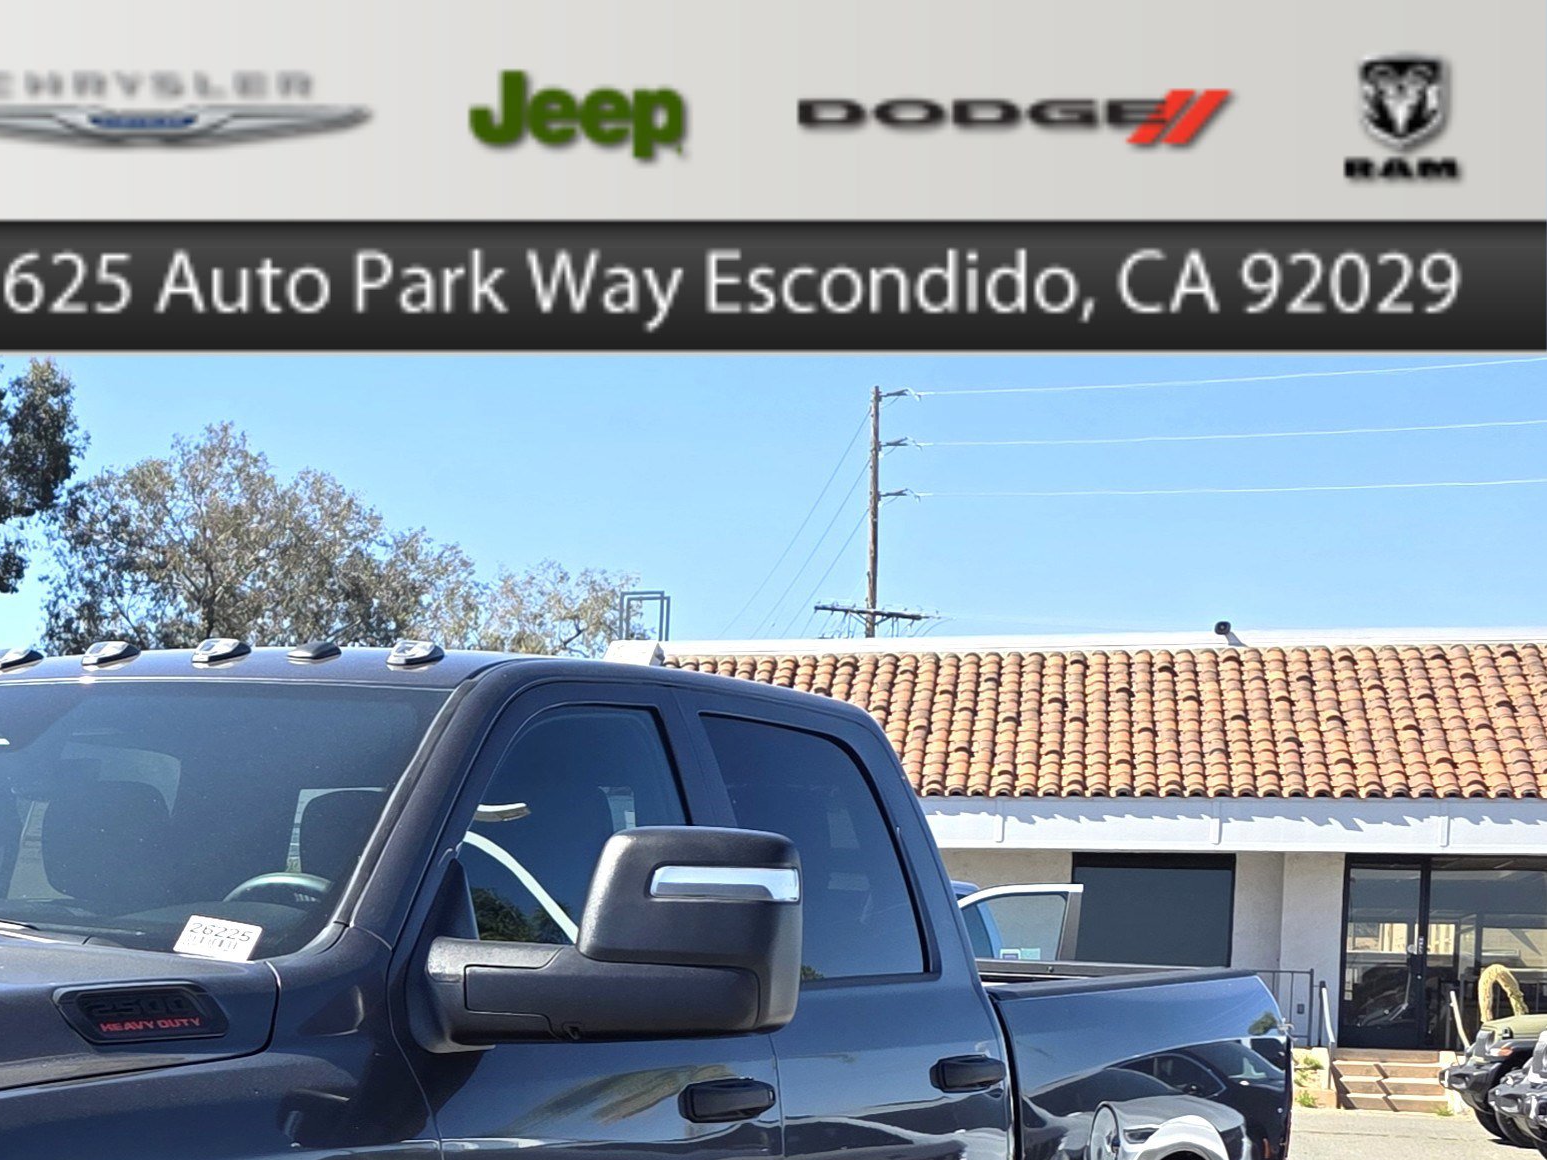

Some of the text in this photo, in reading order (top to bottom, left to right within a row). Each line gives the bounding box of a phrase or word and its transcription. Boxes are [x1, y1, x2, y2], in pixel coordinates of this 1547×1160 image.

[189, 922, 254, 943] 26225
[99, 1016, 201, 1033] HEAVY DUTY
